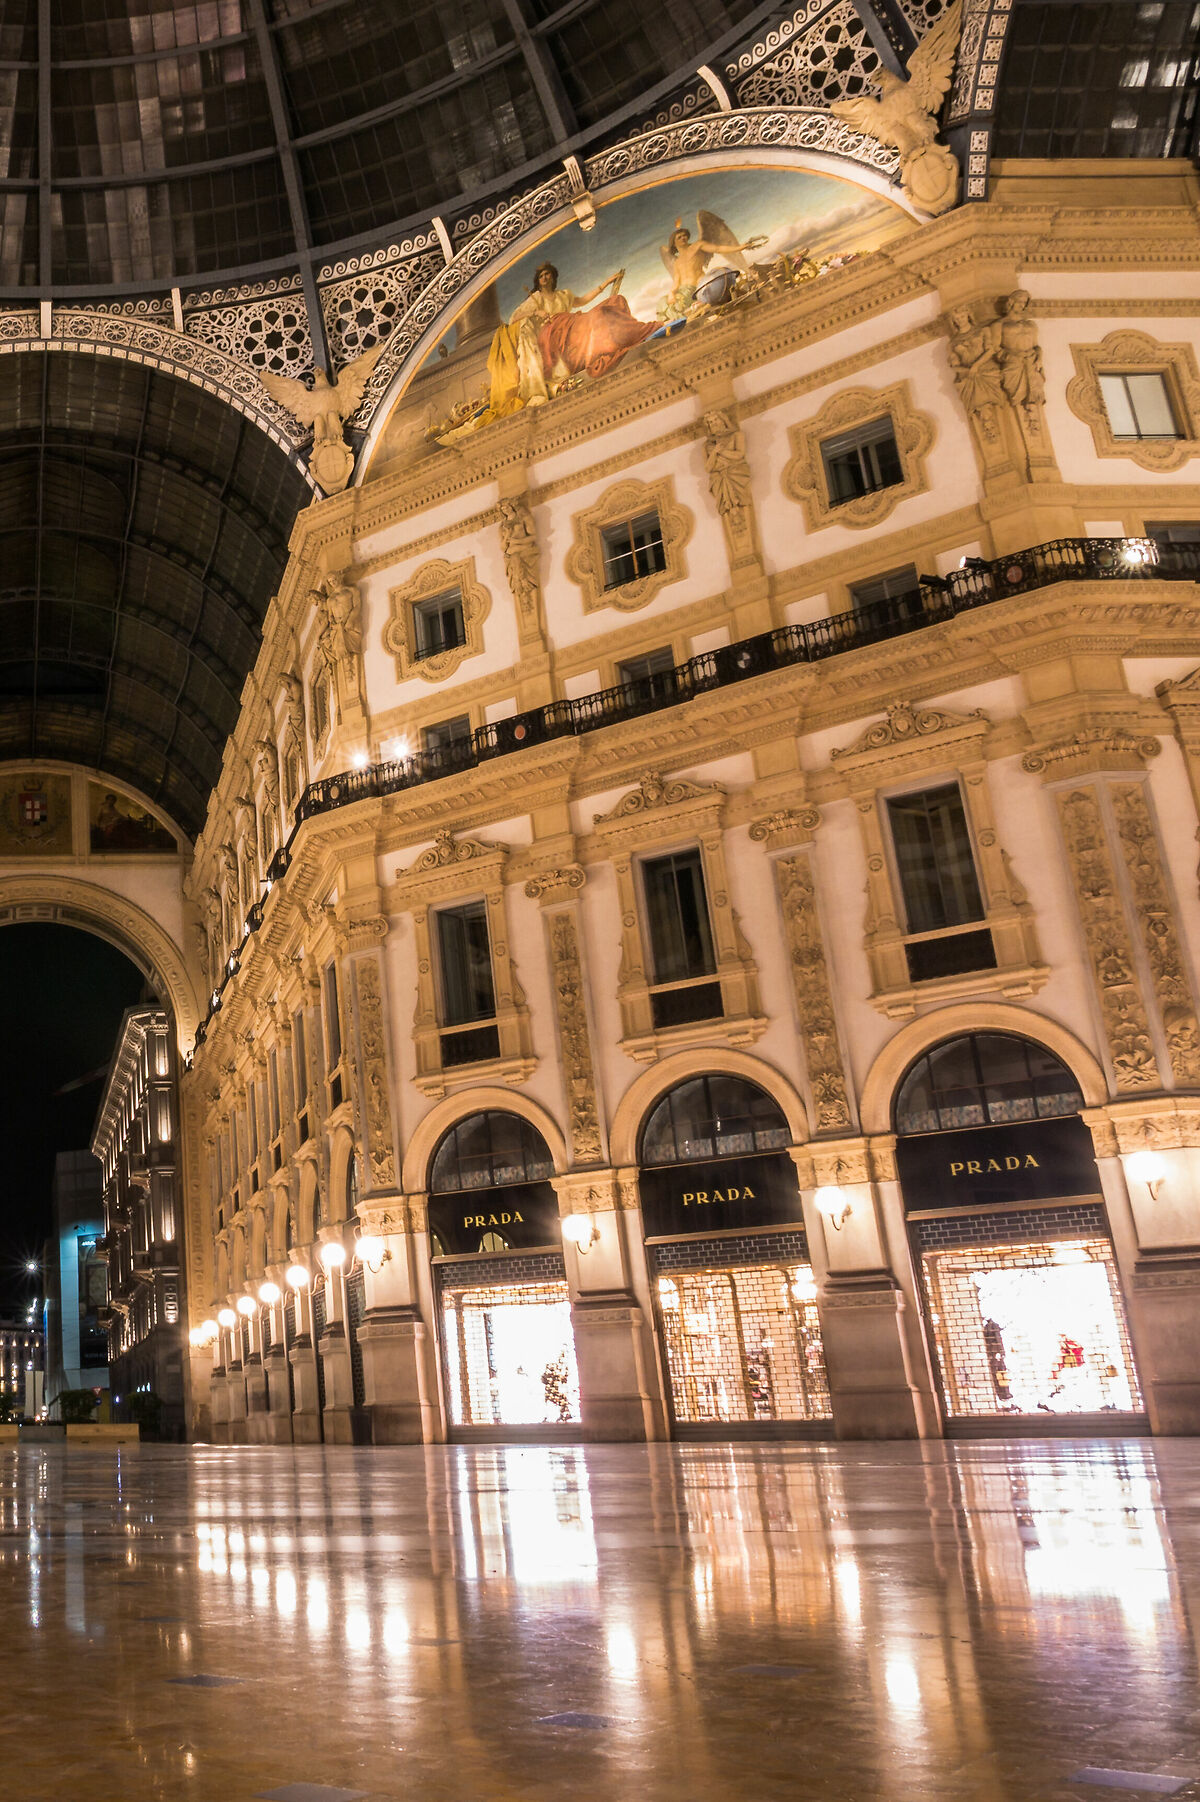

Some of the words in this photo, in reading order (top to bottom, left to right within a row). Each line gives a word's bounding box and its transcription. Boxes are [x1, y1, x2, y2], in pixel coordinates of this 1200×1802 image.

[950, 1153, 1041, 1177] PRADA
[682, 1185, 756, 1207] PRADA
[463, 1210, 524, 1229] PRADA
